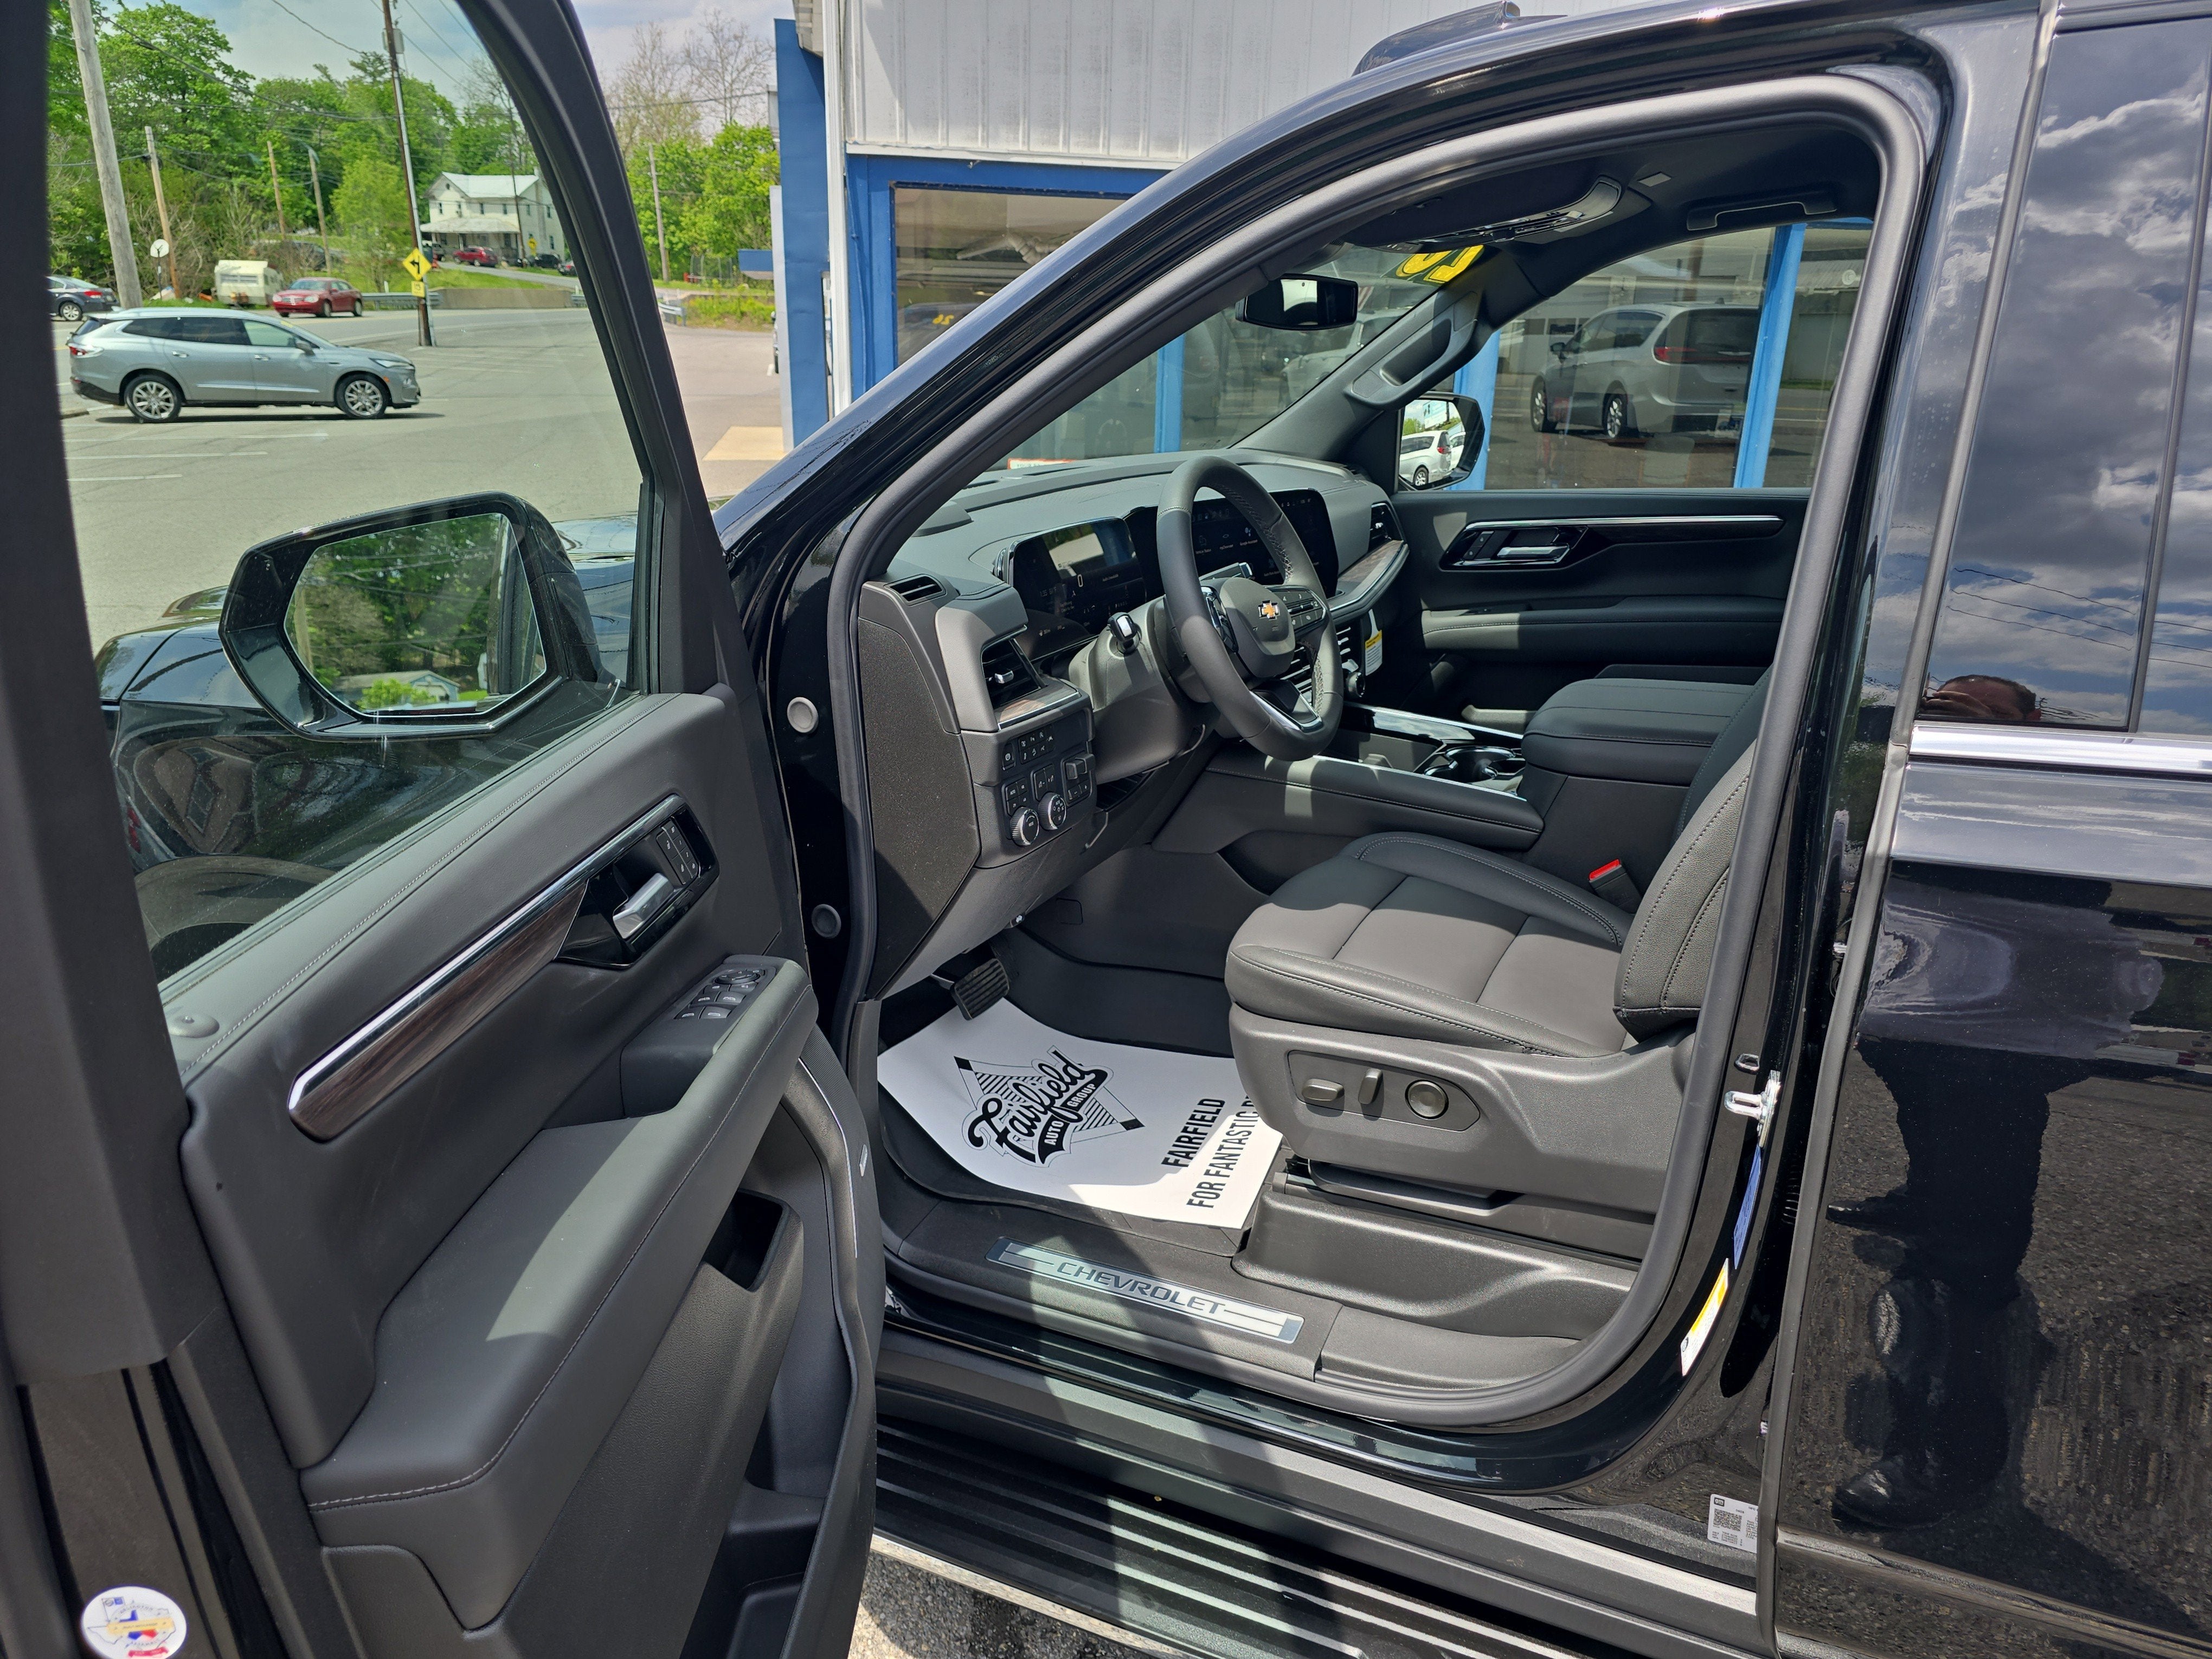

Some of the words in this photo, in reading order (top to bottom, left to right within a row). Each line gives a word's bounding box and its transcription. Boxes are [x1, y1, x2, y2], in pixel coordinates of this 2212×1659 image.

[968, 1049, 1108, 1164] Fairfield
[1044, 1120, 1065, 1146] AUTO
[1066, 1083, 1097, 1108] GROUP
[1161, 1098, 1226, 1168] FAIRFIELD
[1203, 1111, 1260, 1178] FANTASTIC
[1186, 1181, 1227, 1208] FOR
[1057, 1262, 1226, 1314] CHEVROLET
